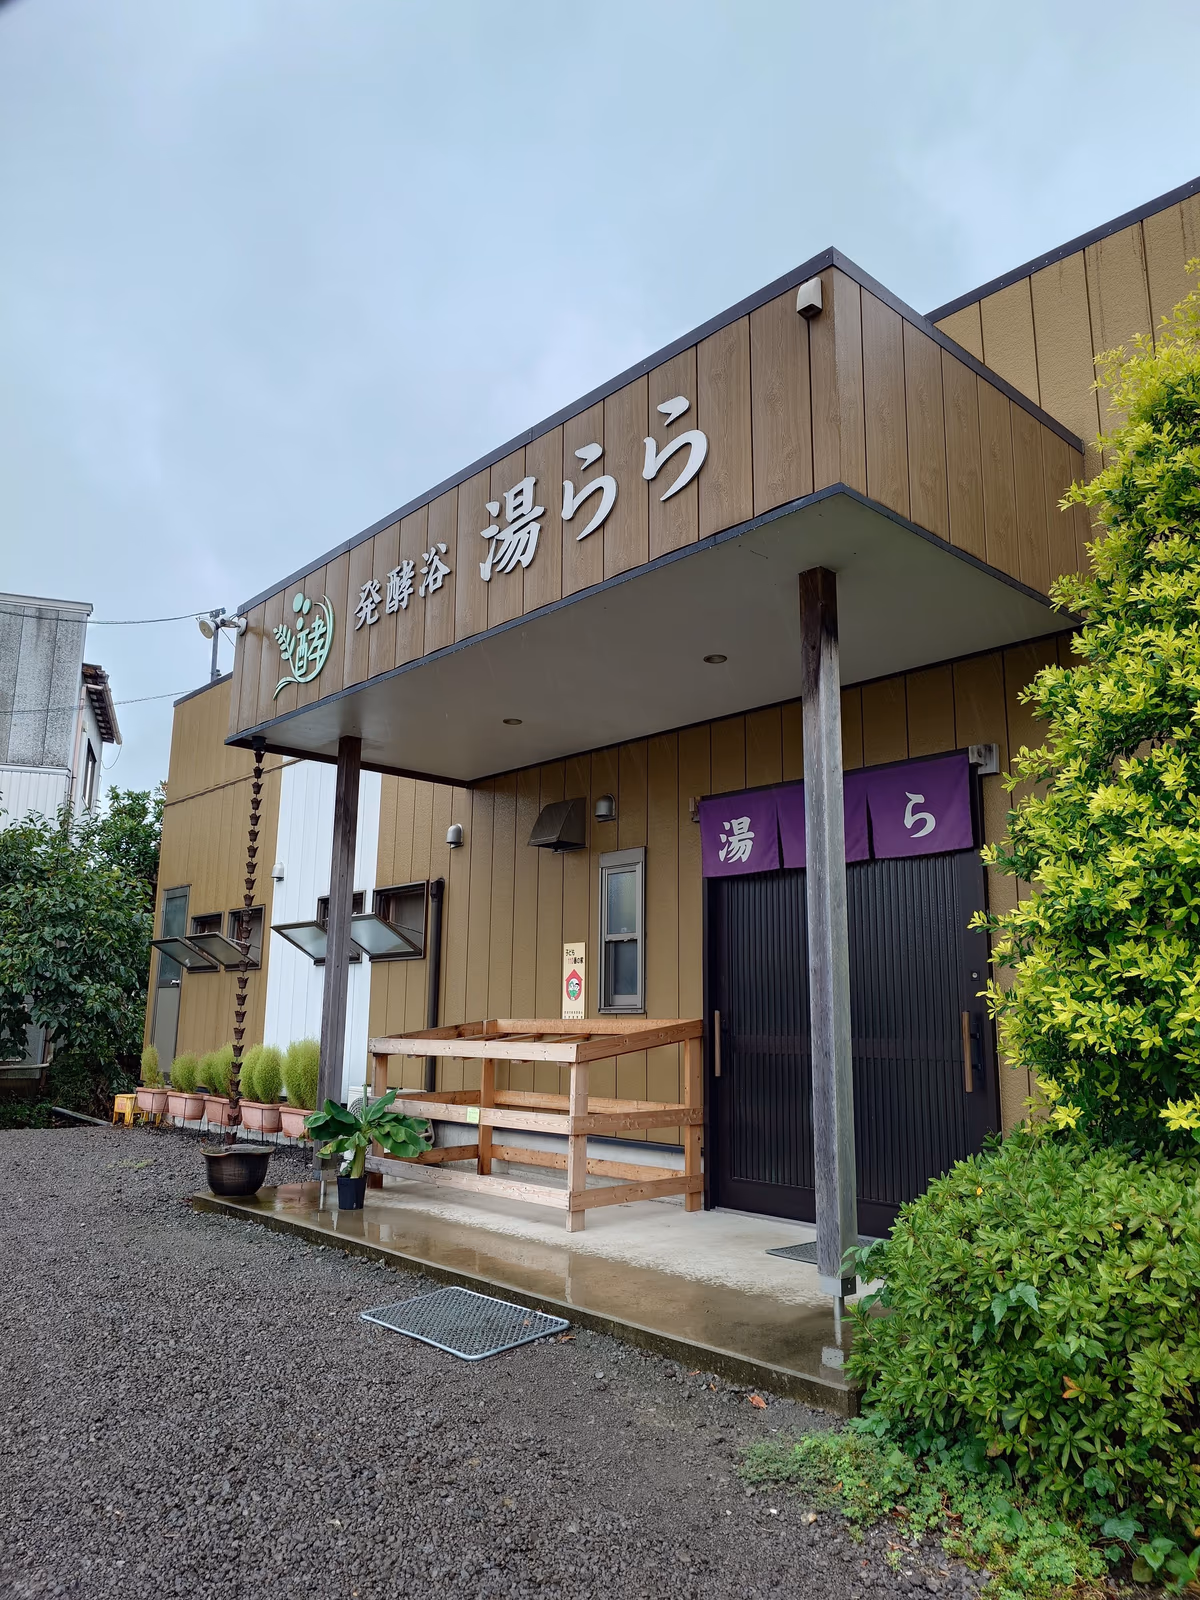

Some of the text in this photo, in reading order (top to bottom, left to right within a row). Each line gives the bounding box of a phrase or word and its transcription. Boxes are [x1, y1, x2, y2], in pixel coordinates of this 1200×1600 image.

[354, 395, 710, 631] 発酵浴 湯らら
